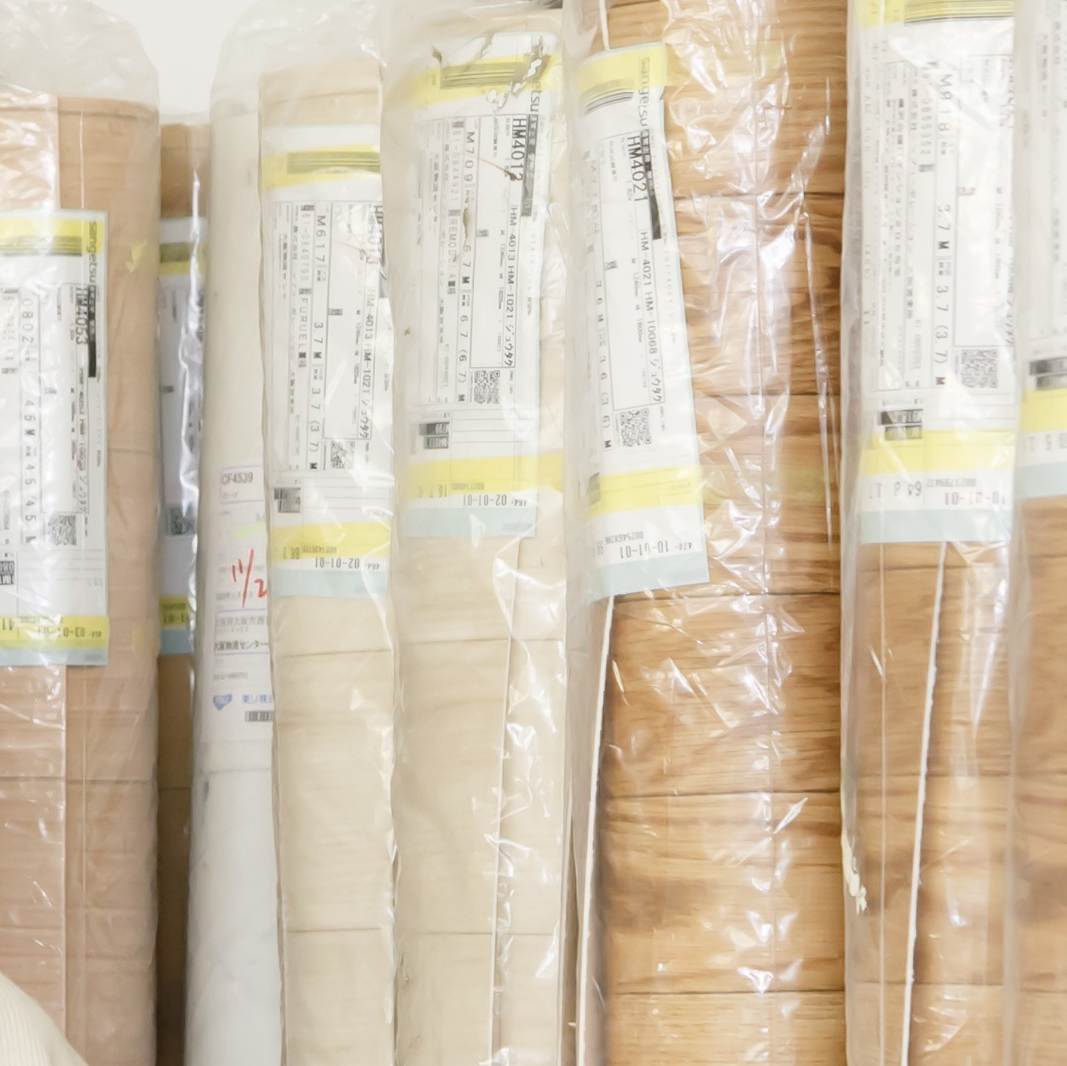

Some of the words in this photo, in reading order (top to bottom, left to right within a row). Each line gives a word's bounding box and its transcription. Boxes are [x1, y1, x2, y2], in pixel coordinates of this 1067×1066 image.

[638, 56, 650, 127] sangetsu
[463, 131, 475, 182] M709
[627, 136, 648, 202] HM4021
[87, 221, 98, 283] sangetsu
[315, 215, 327, 263] M617
[507, 207, 518, 261] HM-4013
[640, 231, 652, 287] HM-4021
[506, 265, 516, 319] HM-1021
[645, 292, 658, 355] HM-10068
[462, 494, 507, 507] 02-01-01
[314, 557, 360, 570] 02-01-01
